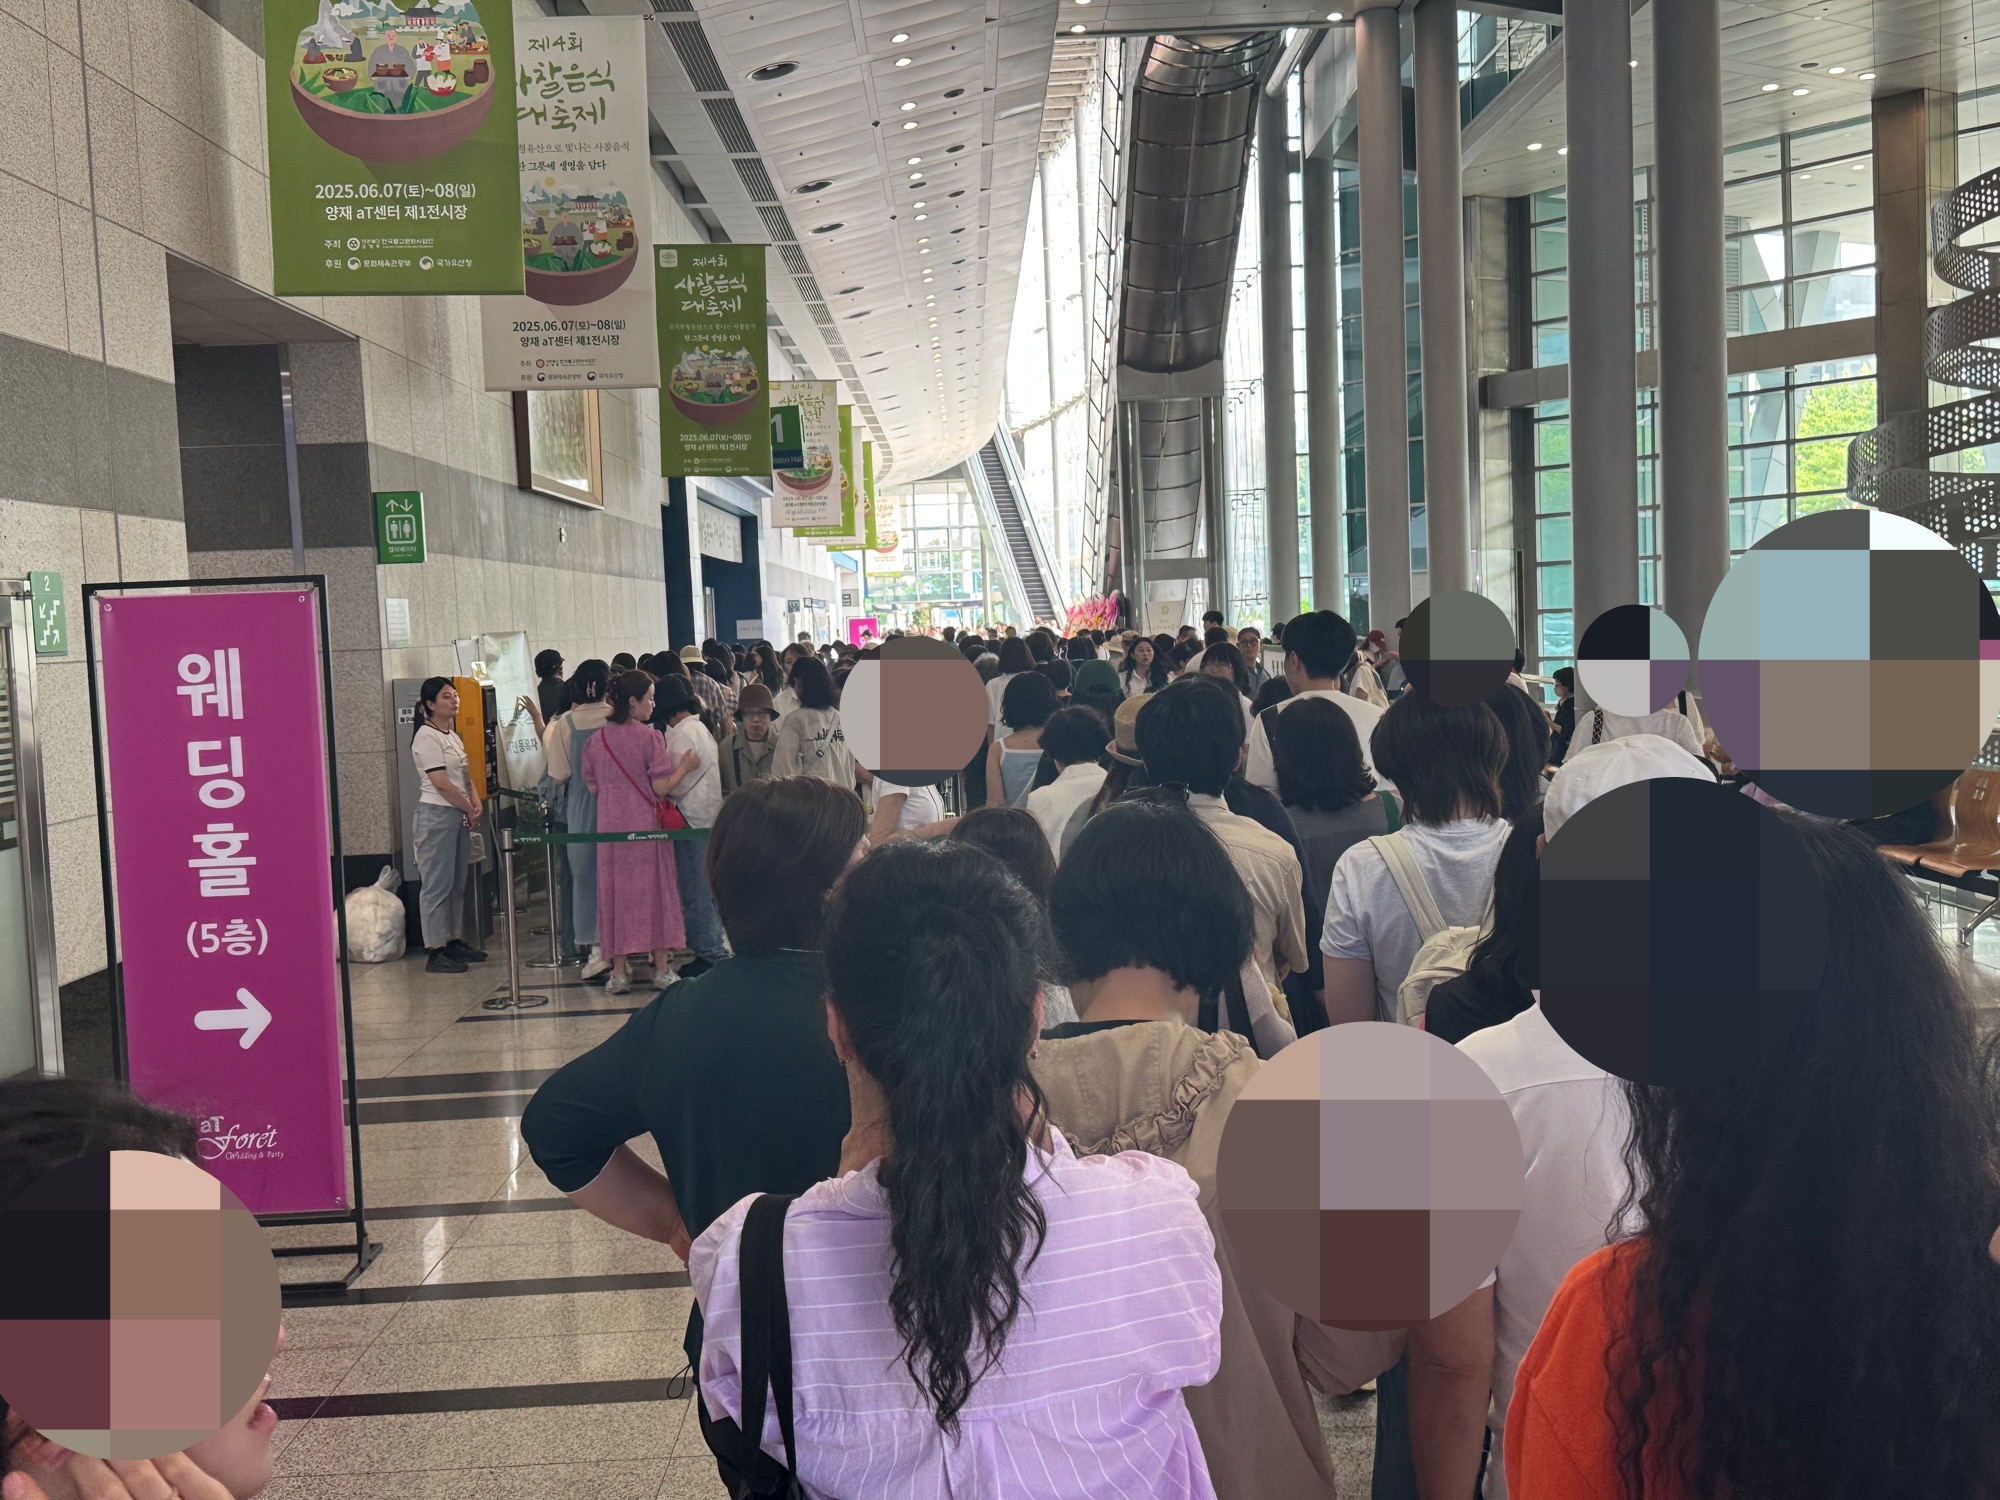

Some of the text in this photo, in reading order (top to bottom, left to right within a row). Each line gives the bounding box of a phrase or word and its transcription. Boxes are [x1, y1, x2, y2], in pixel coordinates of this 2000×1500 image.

[528, 32, 582, 52] 제4회
[517, 96, 606, 132] 대축제
[560, 160, 586, 171] 생명을
[588, 159, 607, 170] 담다
[315, 183, 476, 199] 2025.06.07(토)~08(일)
[325, 204, 468, 221] 양재 aT센터 제1전시장
[324, 239, 341, 249] 주최
[325, 259, 342, 269] 후원
[692, 254, 728, 268] 제4회
[674, 272, 748, 297] 사찰음식
[681, 294, 742, 318] 대축제
[512, 319, 626, 332] 2025.06.07(토)~08(일)
[520, 334, 620, 347] 양재 aT센터 제1전시장
[44, 575, 50, 592] 2
[176, 648, 257, 898] 웨딩홀
[186, 918, 268, 958] (5층)
[200, 1115, 225, 1133] aT
